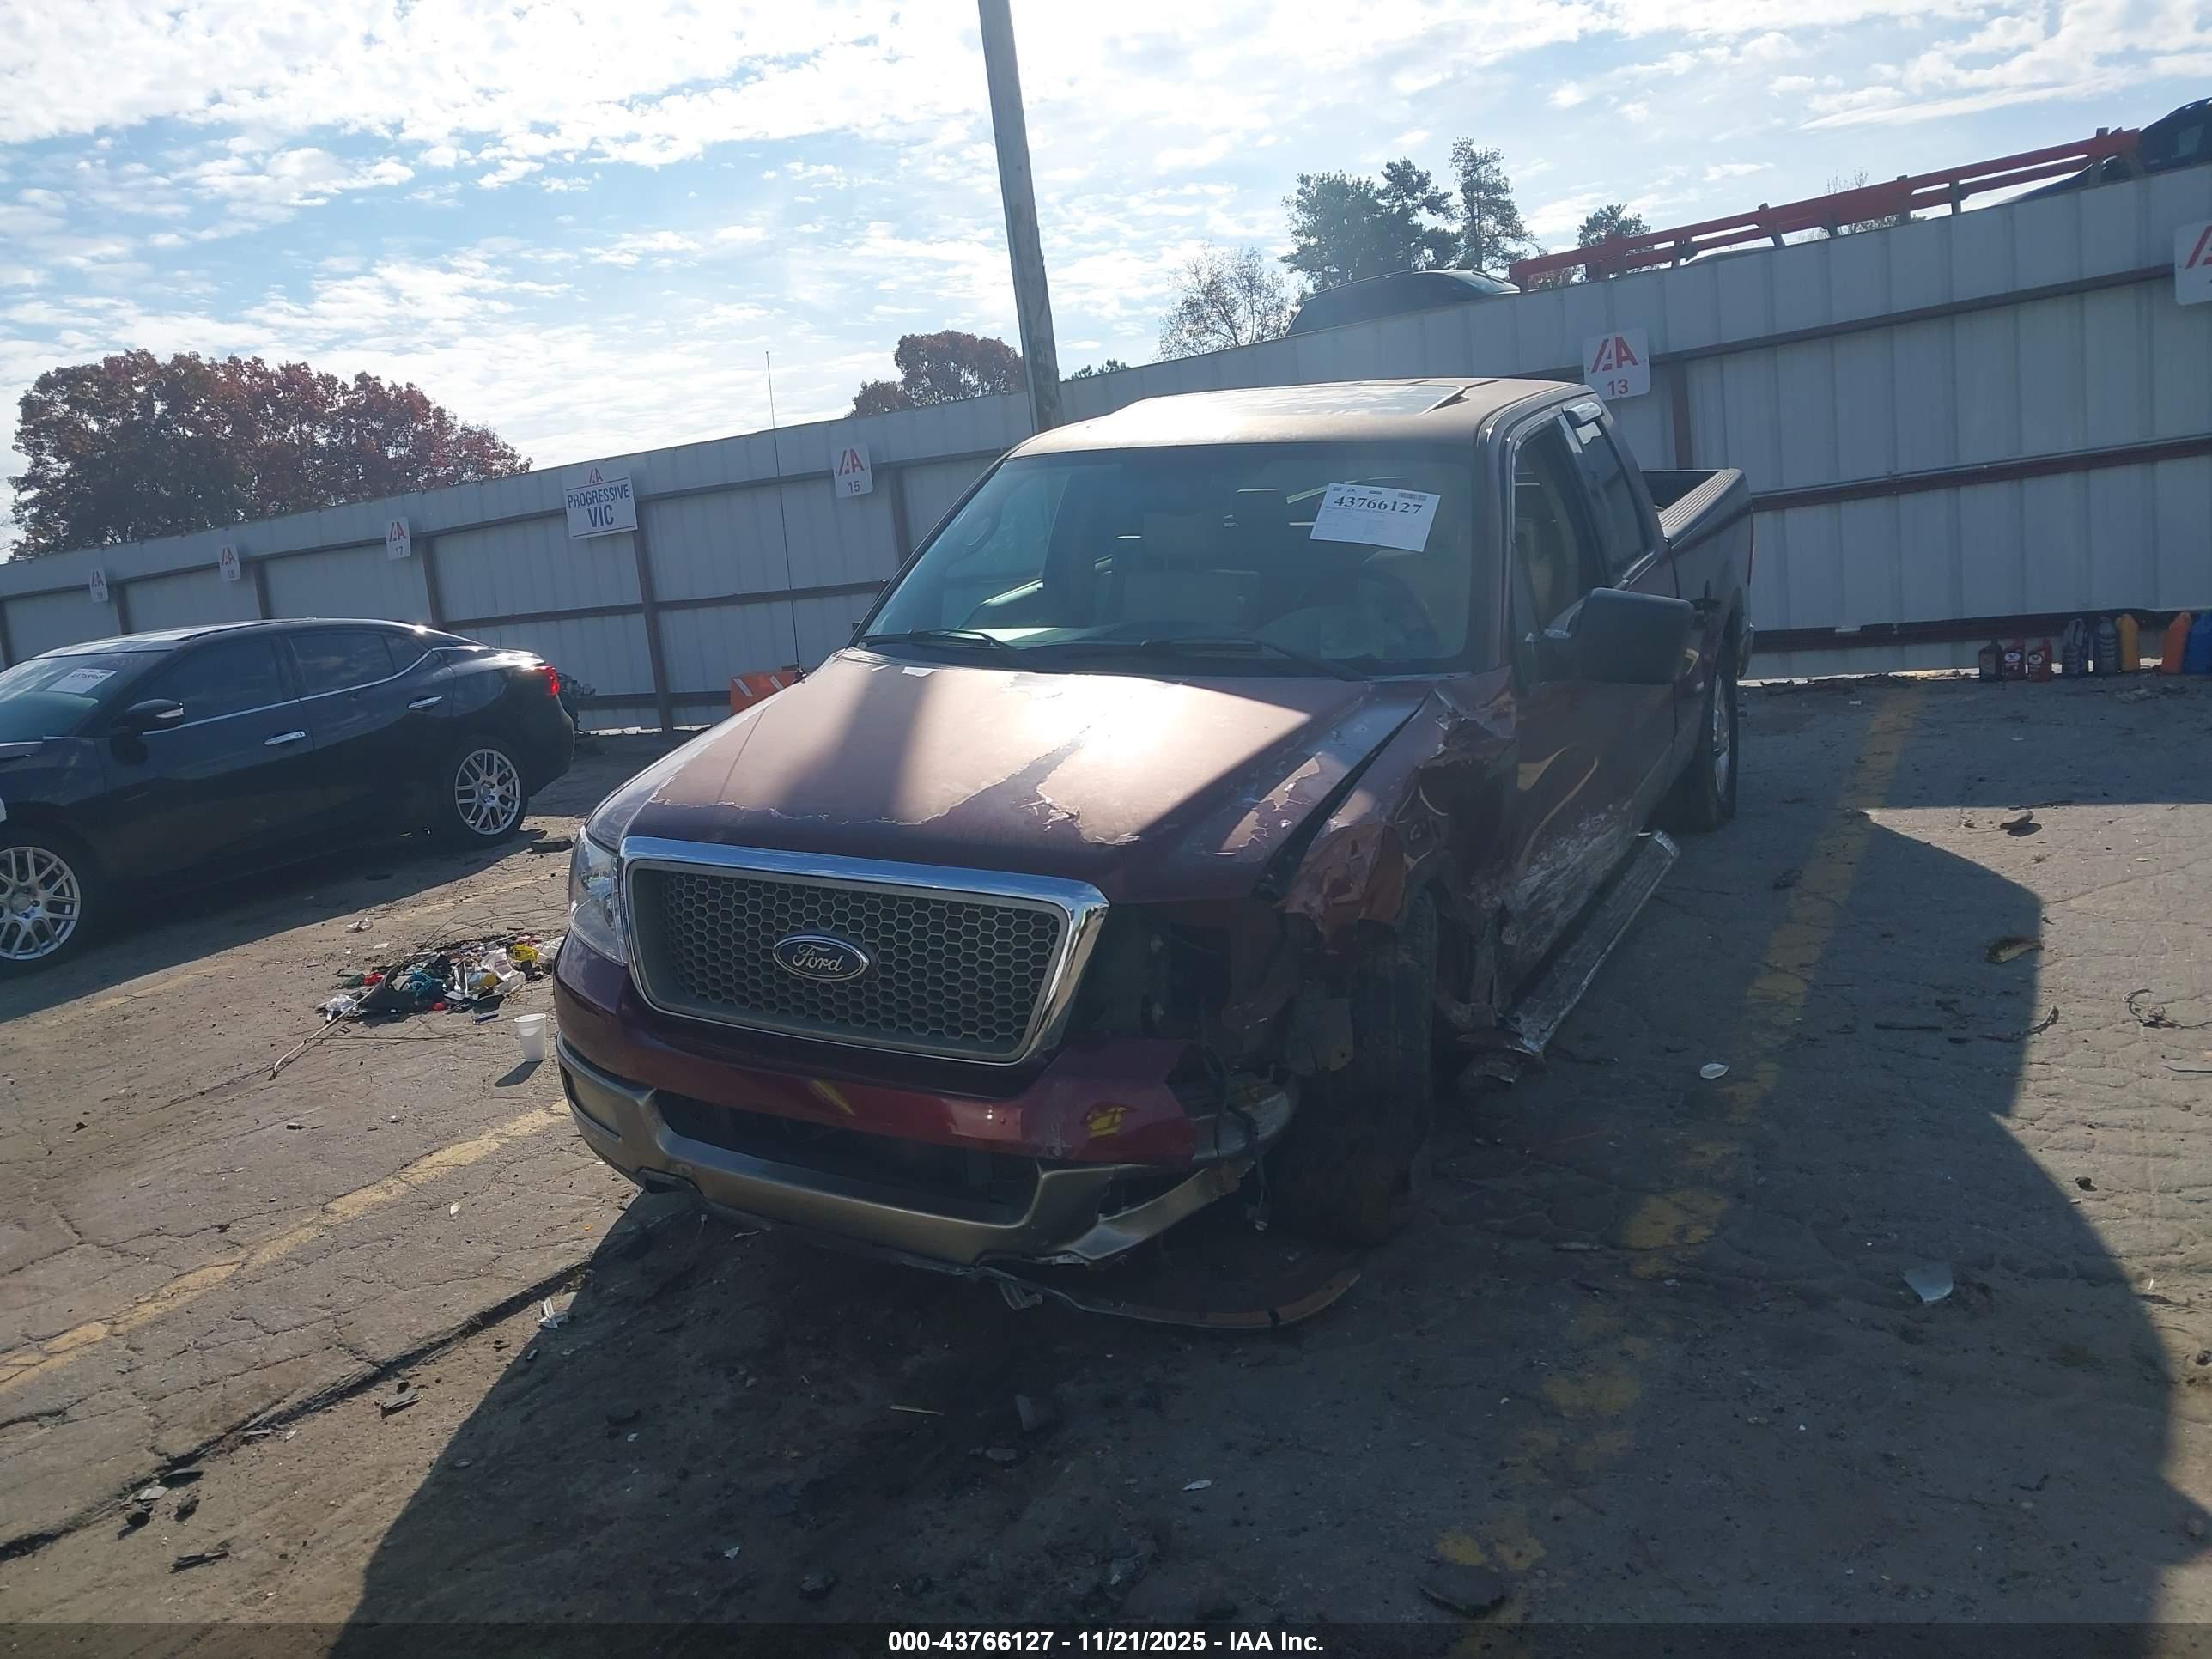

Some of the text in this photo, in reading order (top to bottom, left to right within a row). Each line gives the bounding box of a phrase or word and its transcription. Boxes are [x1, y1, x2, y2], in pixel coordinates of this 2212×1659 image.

[1607, 379, 1629, 396] 13
[567, 483, 630, 509] PROGRESSIVE
[848, 480, 860, 494] 15
[1334, 495, 1423, 515] 43766127
[587, 505, 614, 527] VIC
[395, 545, 404, 556] 17
[792, 943, 845, 972] Ford
